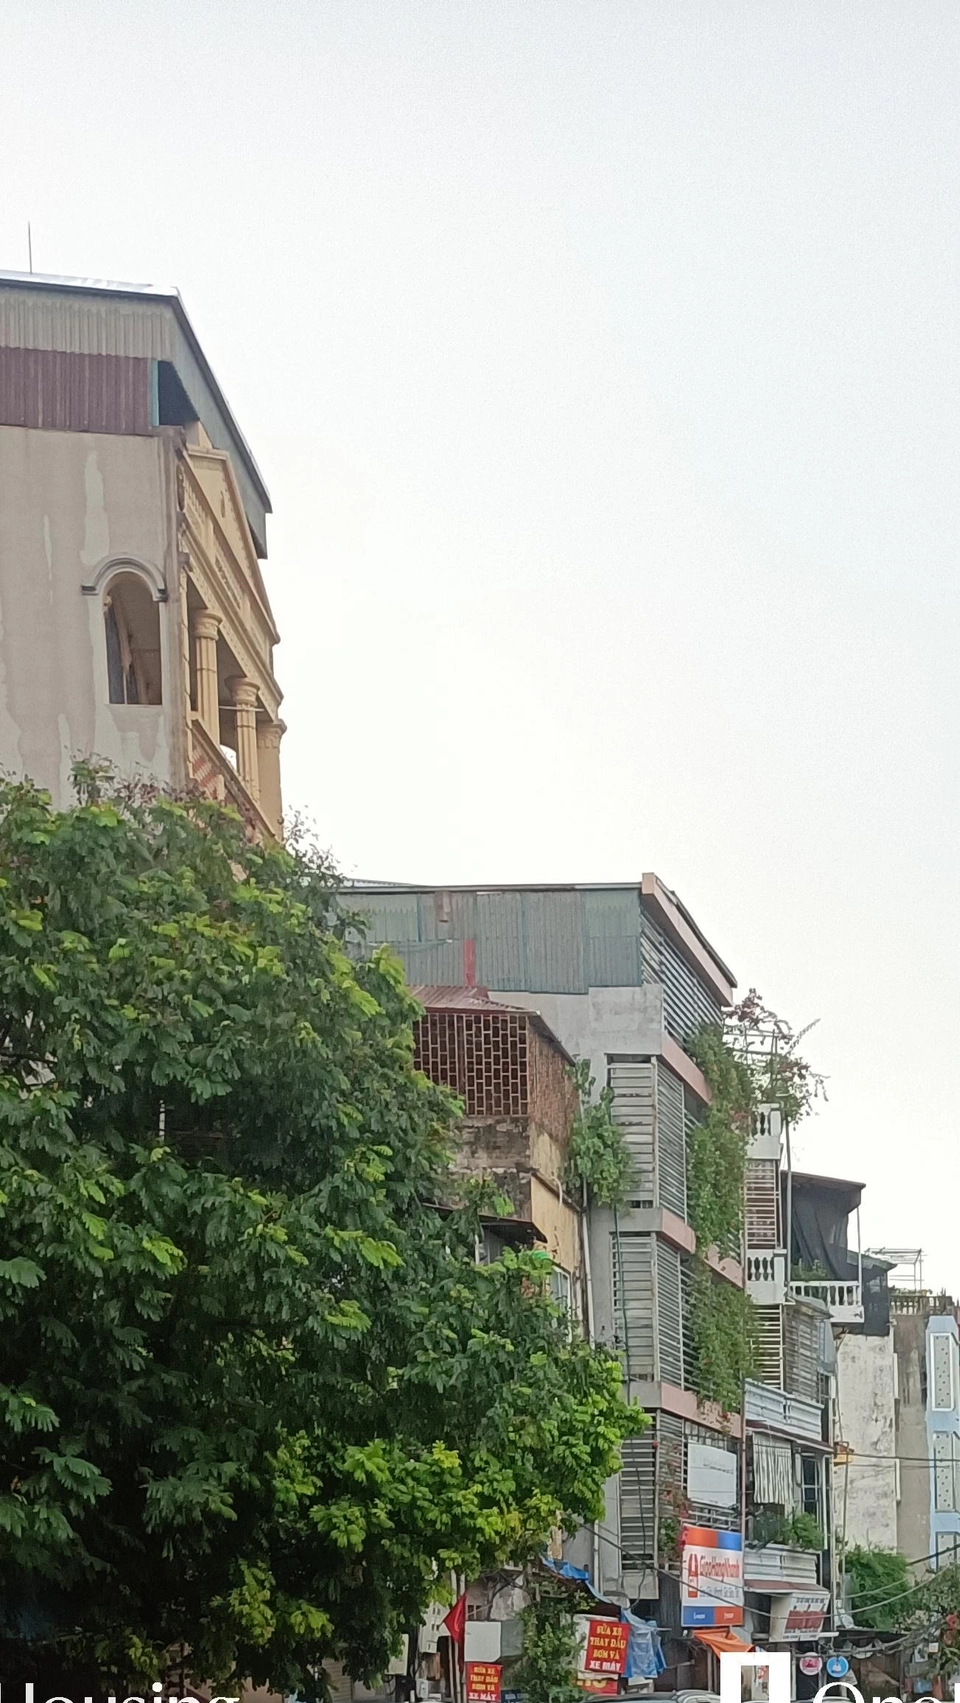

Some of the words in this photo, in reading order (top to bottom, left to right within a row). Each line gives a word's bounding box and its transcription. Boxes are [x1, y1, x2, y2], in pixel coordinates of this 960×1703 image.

[590, 1637, 609, 1647] THAY
[589, 1660, 601, 1670] XE
[602, 1660, 622, 1671] MÁY
[480, 1691, 497, 1701] MÁY
